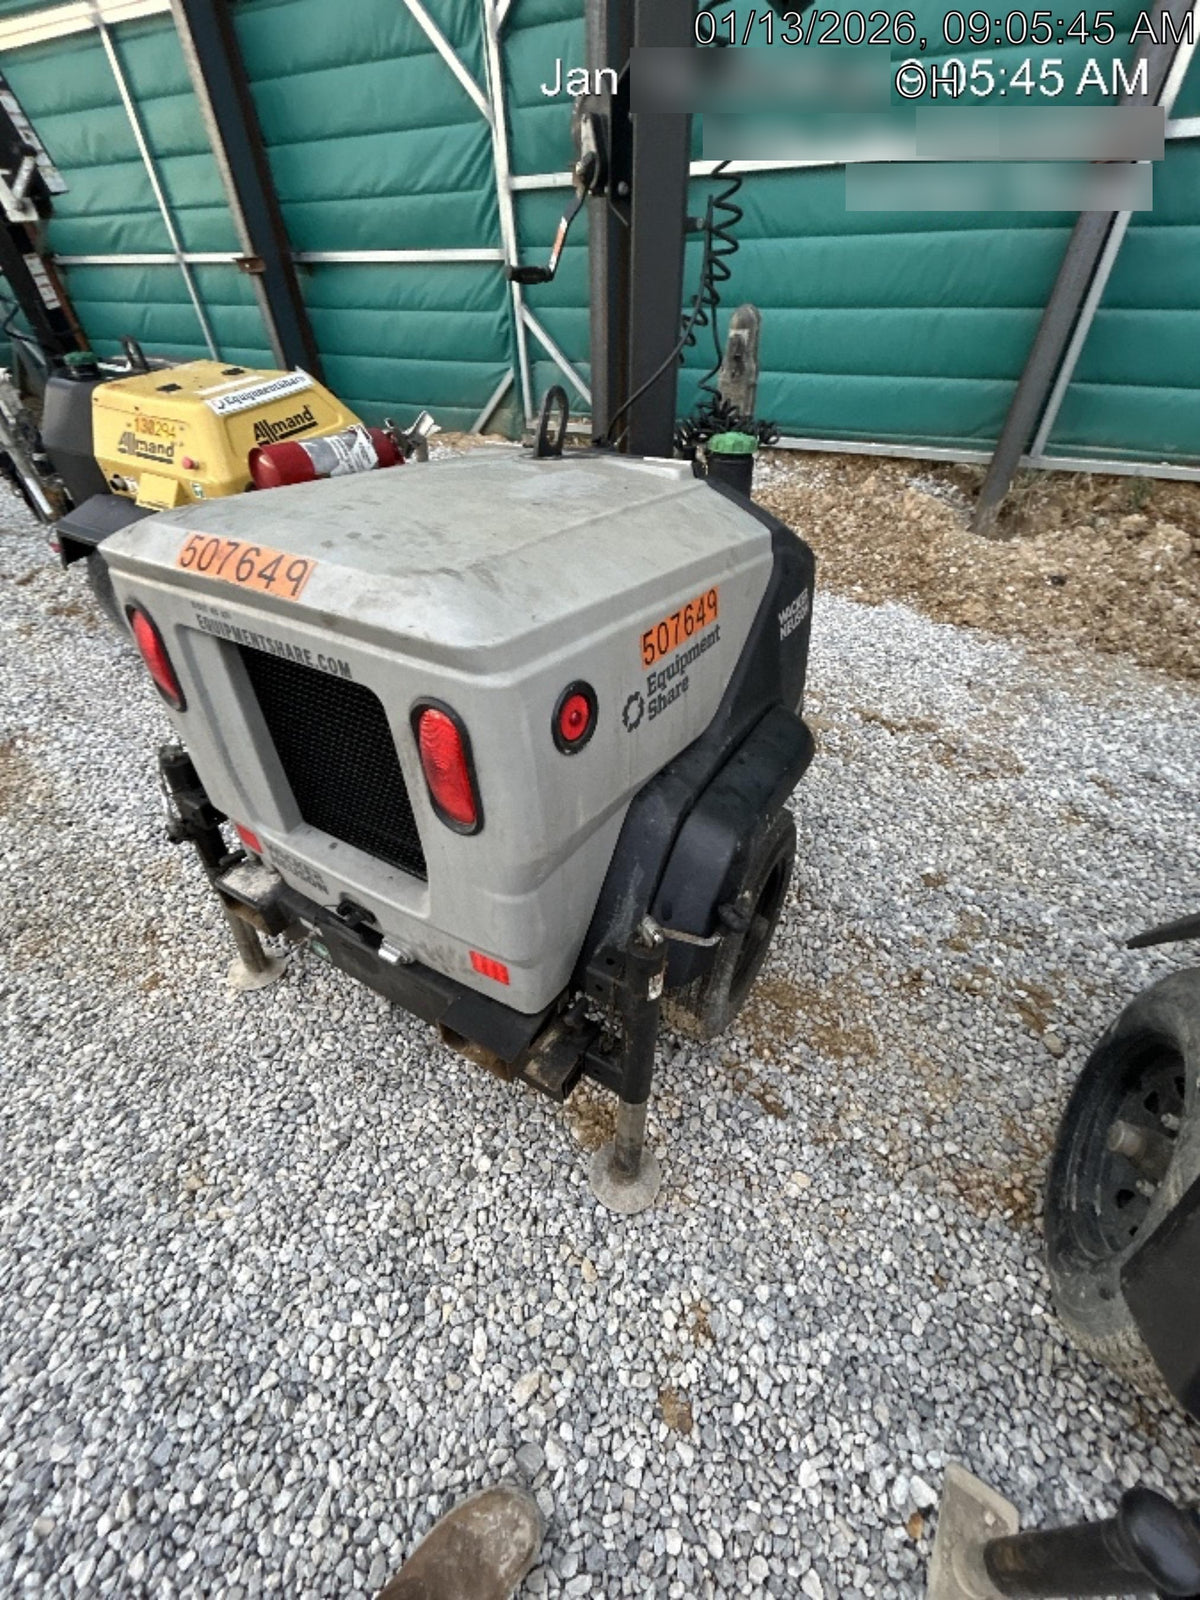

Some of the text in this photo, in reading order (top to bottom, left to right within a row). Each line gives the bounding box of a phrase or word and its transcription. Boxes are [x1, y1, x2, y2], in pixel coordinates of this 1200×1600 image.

[118, 431, 174, 457] Allmand
[253, 404, 316, 444] Allmand
[180, 534, 308, 597] 507649
[196, 613, 353, 680] EQUIPMENTSHARE.COM
[642, 588, 718, 666] 507649
[647, 624, 721, 697] Equipment
[647, 675, 689, 721] Share
